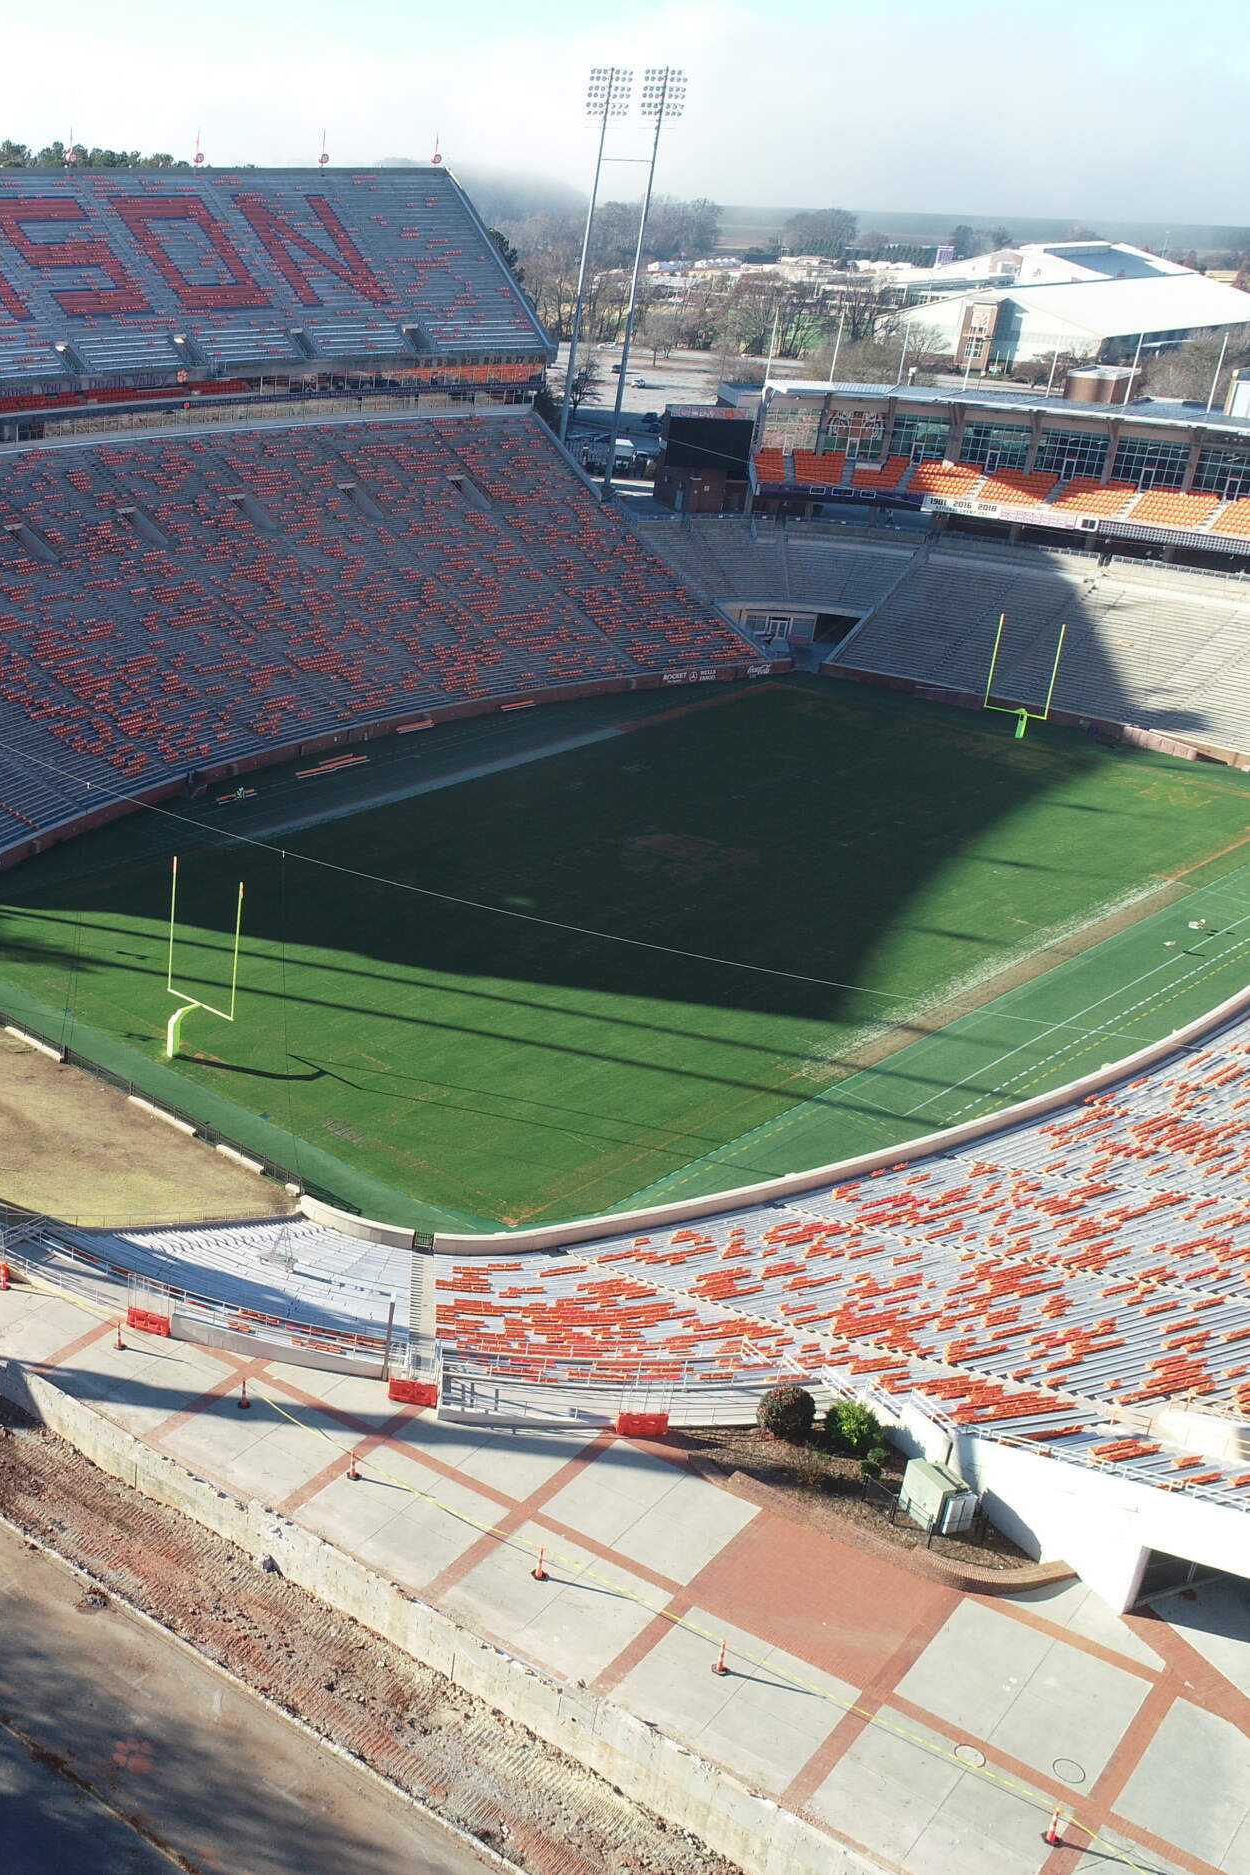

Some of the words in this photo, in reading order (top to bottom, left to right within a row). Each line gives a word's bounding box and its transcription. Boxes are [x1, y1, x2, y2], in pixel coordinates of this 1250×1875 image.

[88, 376, 126, 390] Death
[132, 373, 168, 387] Valley
[953, 500, 972, 509] 2016
[978, 503, 998, 513] 2018
